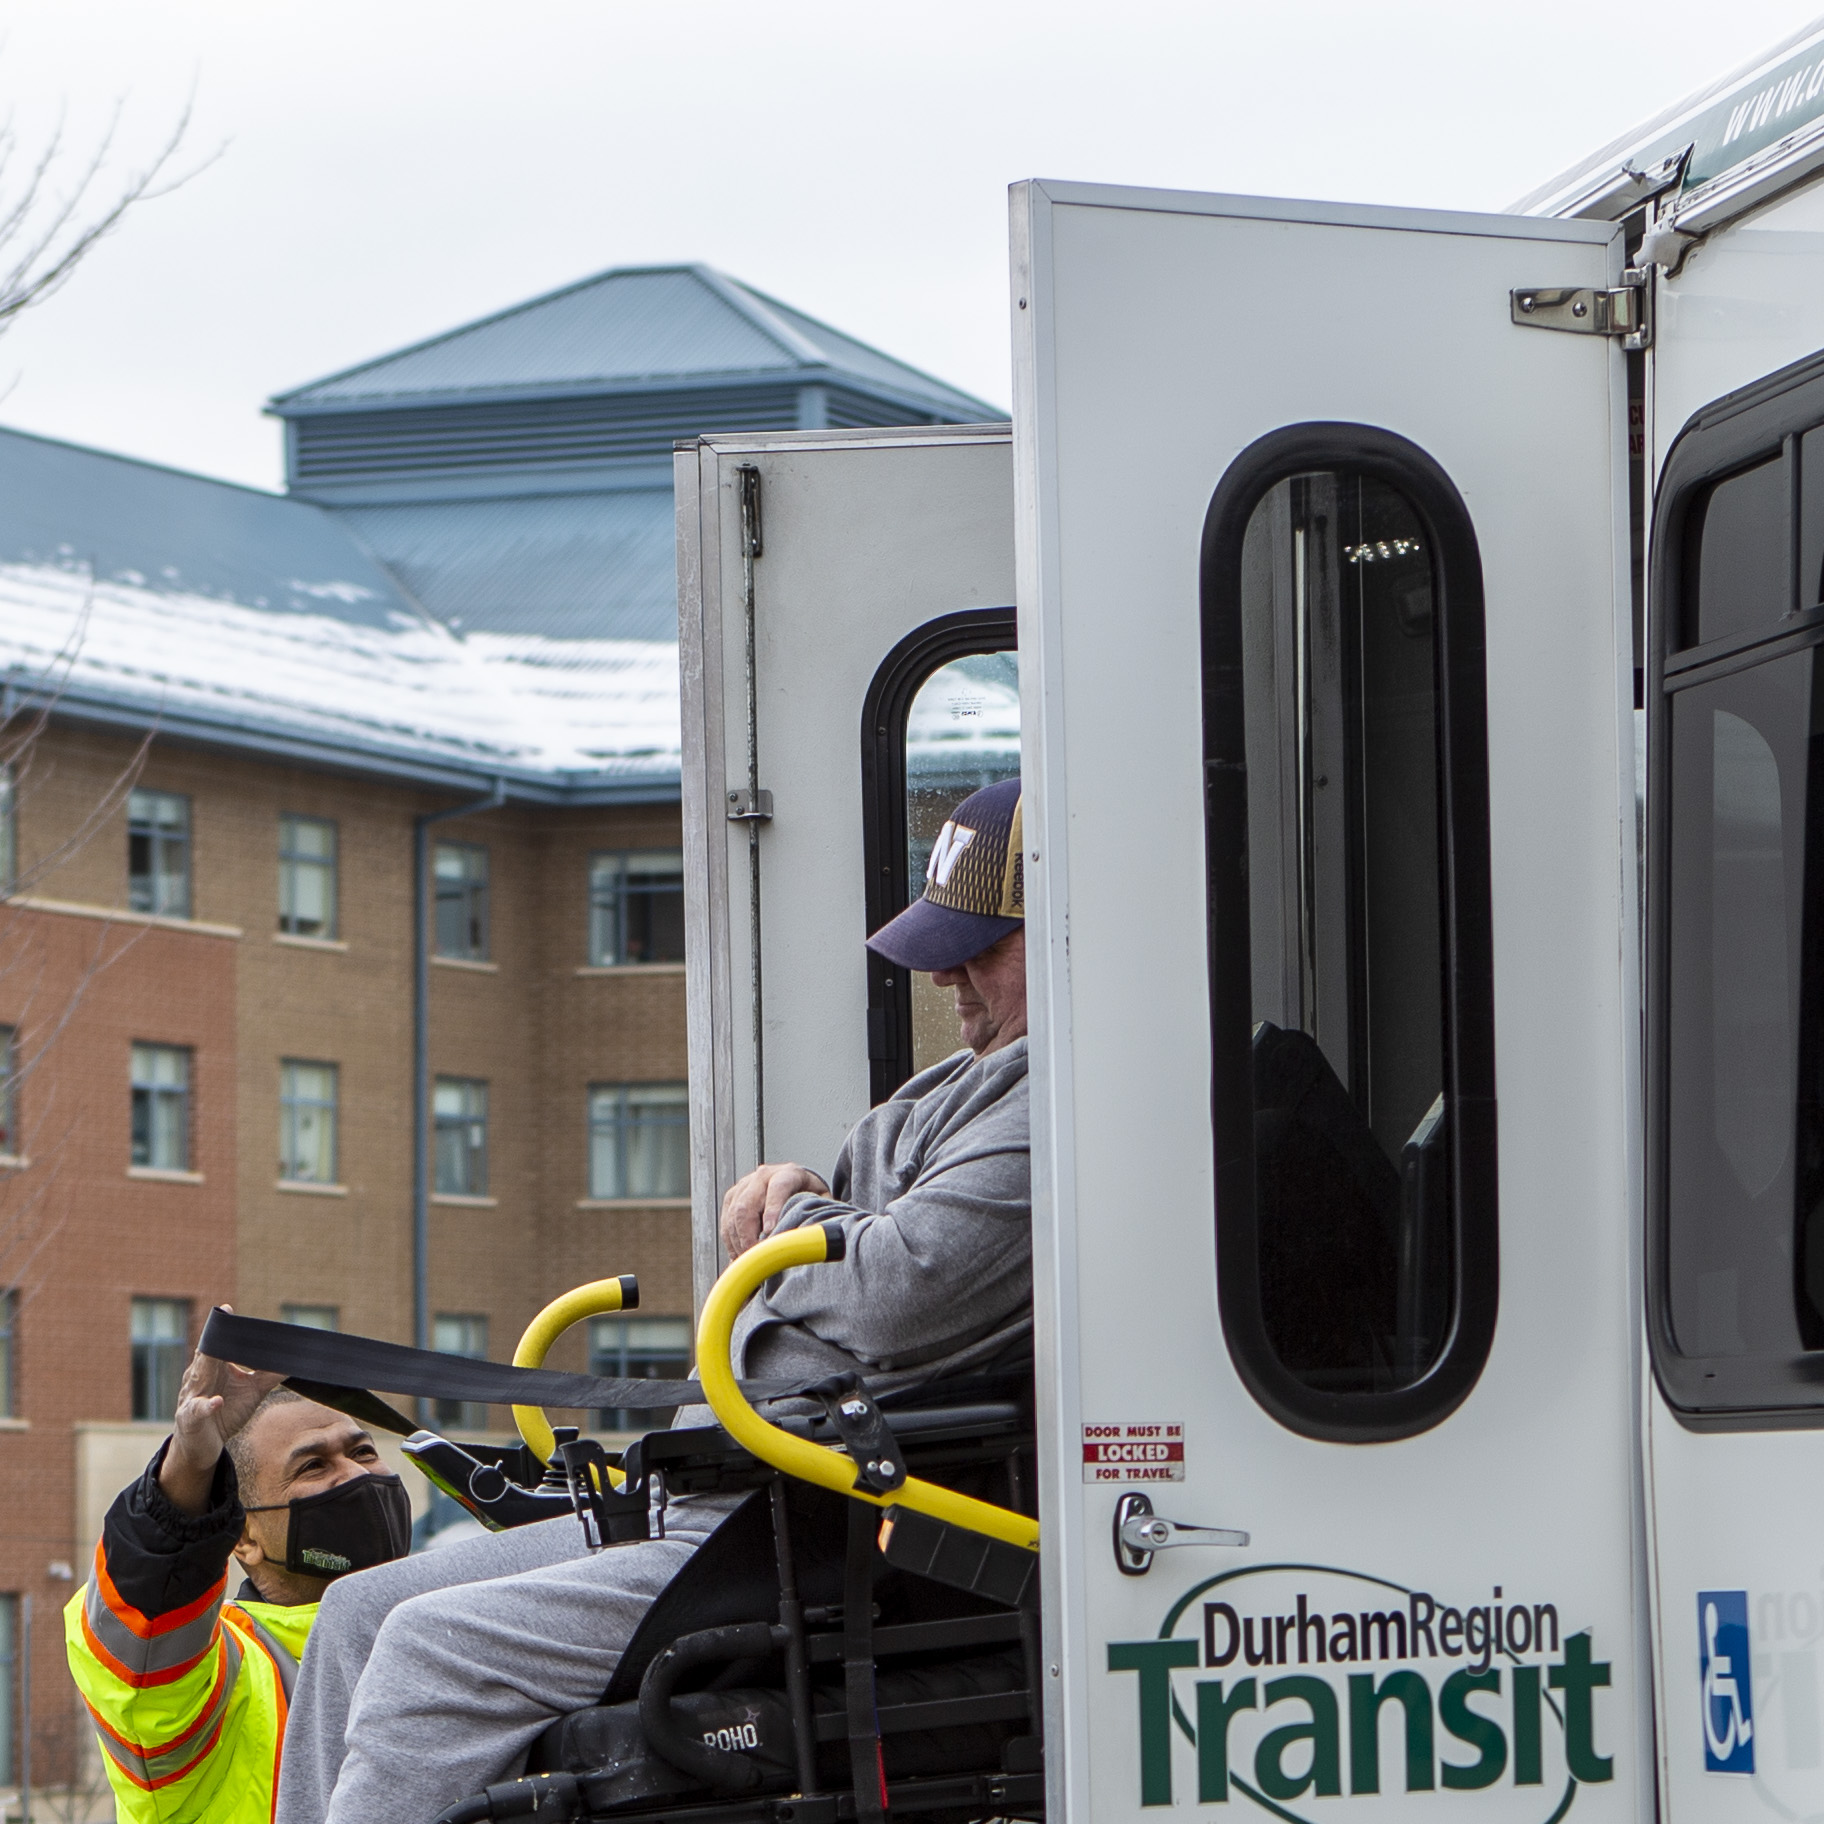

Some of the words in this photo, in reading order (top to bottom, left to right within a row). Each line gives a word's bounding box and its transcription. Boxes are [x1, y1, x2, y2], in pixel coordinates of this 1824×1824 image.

[1085, 1426, 1121, 1437] DOOR
[1127, 1426, 1161, 1437] MUST
[1166, 1425, 1181, 1436] BE
[1098, 1444, 1169, 1462] LOCKED
[1096, 1468, 1120, 1480] FOR
[1126, 1467, 1171, 1479] TRAVEL
[1106, 1627, 1614, 1808] Transit
